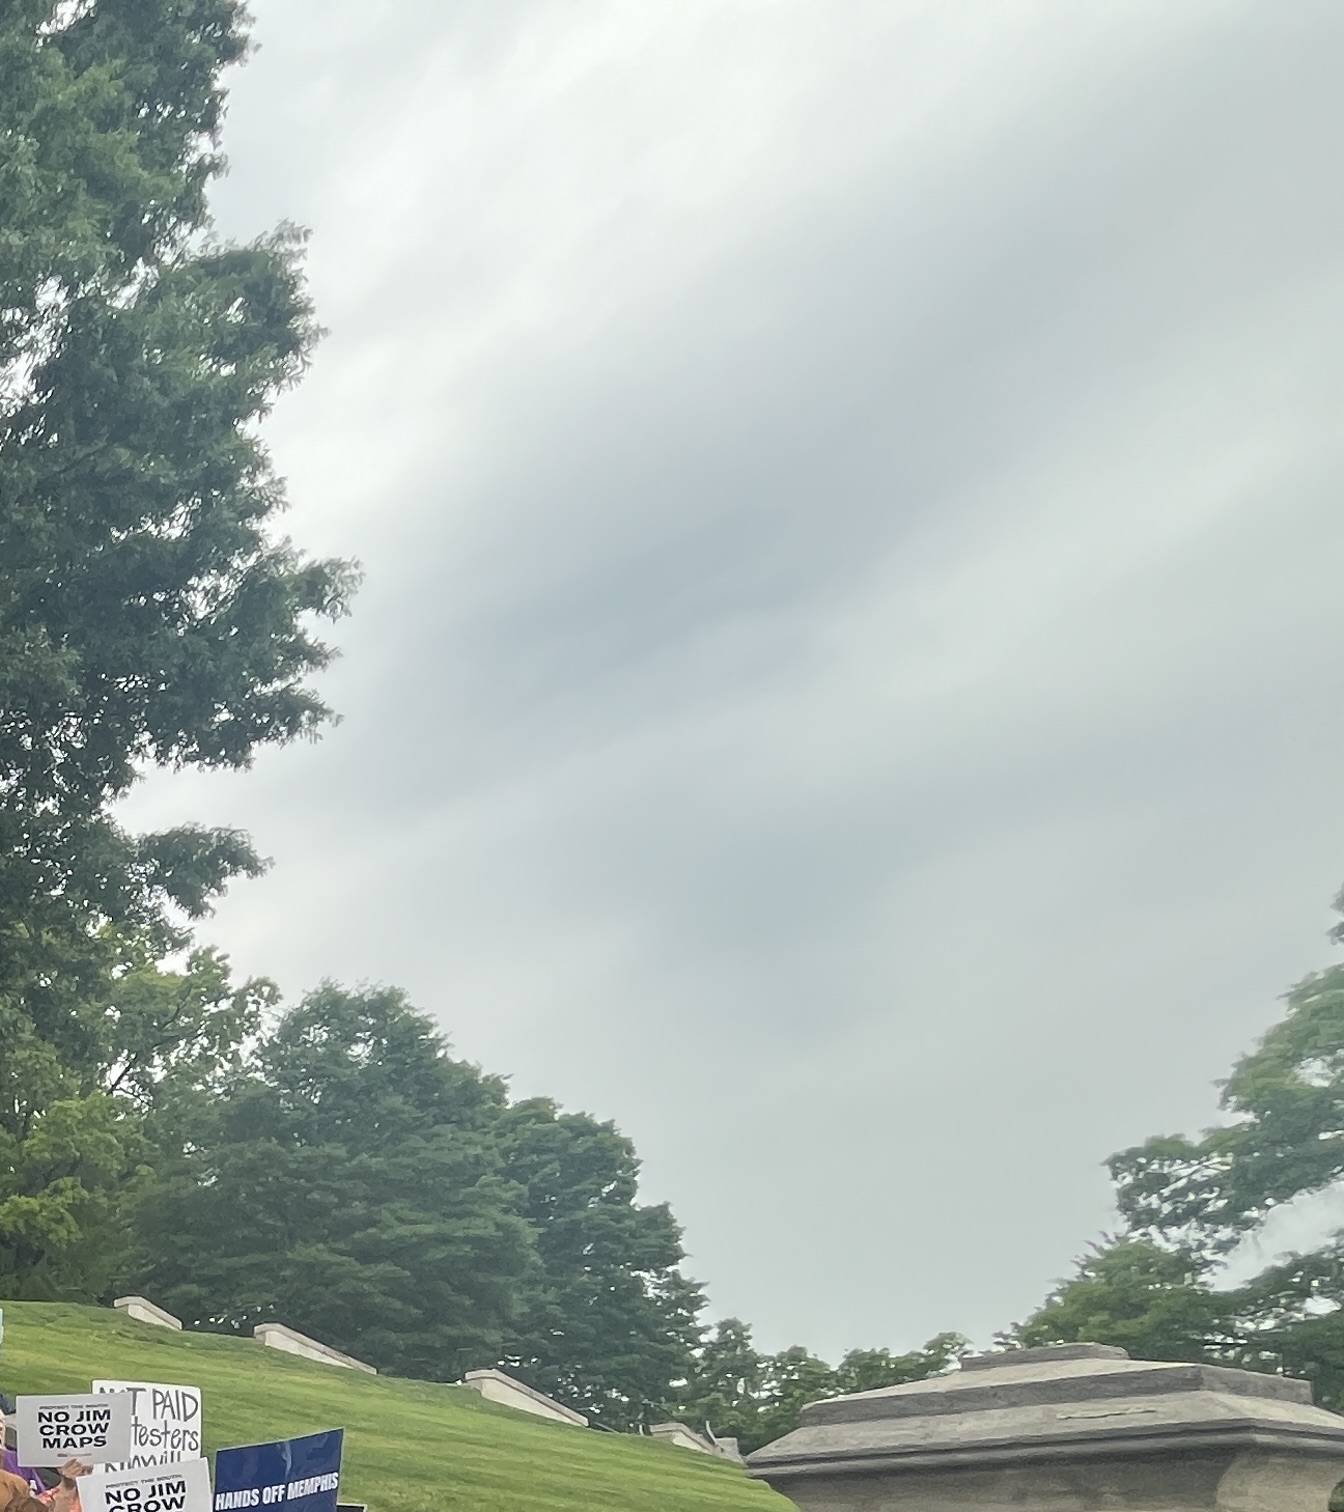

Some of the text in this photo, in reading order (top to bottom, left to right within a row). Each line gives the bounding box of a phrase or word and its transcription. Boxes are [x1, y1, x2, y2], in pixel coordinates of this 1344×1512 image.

[152, 1388, 199, 1422] PAID
[38, 1409, 112, 1423] NO JIM
[39, 1422, 110, 1436] CROW
[42, 1435, 107, 1450] MAPS
[104, 1481, 186, 1505] NO JIM
[215, 1472, 339, 1512] HANDS OFF MEMPHIS
